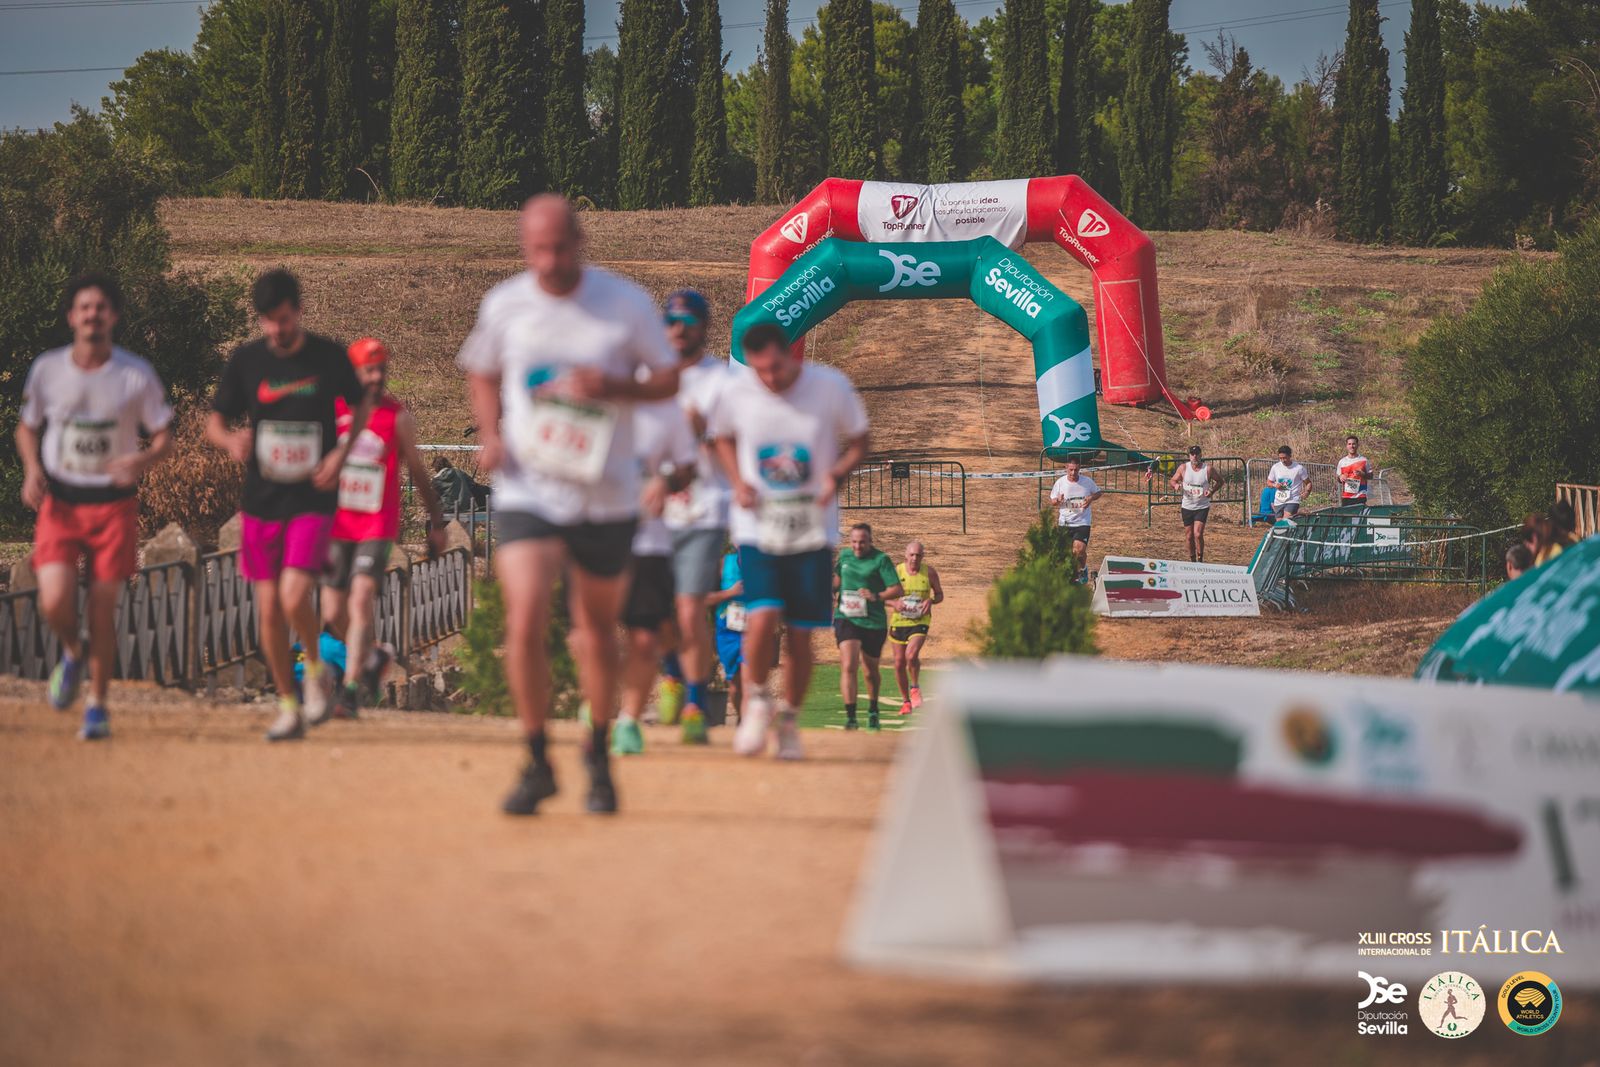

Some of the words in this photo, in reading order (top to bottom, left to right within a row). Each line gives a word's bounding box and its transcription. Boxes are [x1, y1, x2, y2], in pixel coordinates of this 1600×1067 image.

[882, 221, 926, 231] TopRunner
[956, 216, 986, 226] posible
[1059, 226, 1100, 264] TopRunner
[762, 265, 821, 312] Diputación
[984, 267, 1042, 319] Sevilla
[997, 257, 1054, 302] Diputación
[775, 276, 836, 327] Sevilla
[1184, 585, 1252, 603] ITÁLICA
